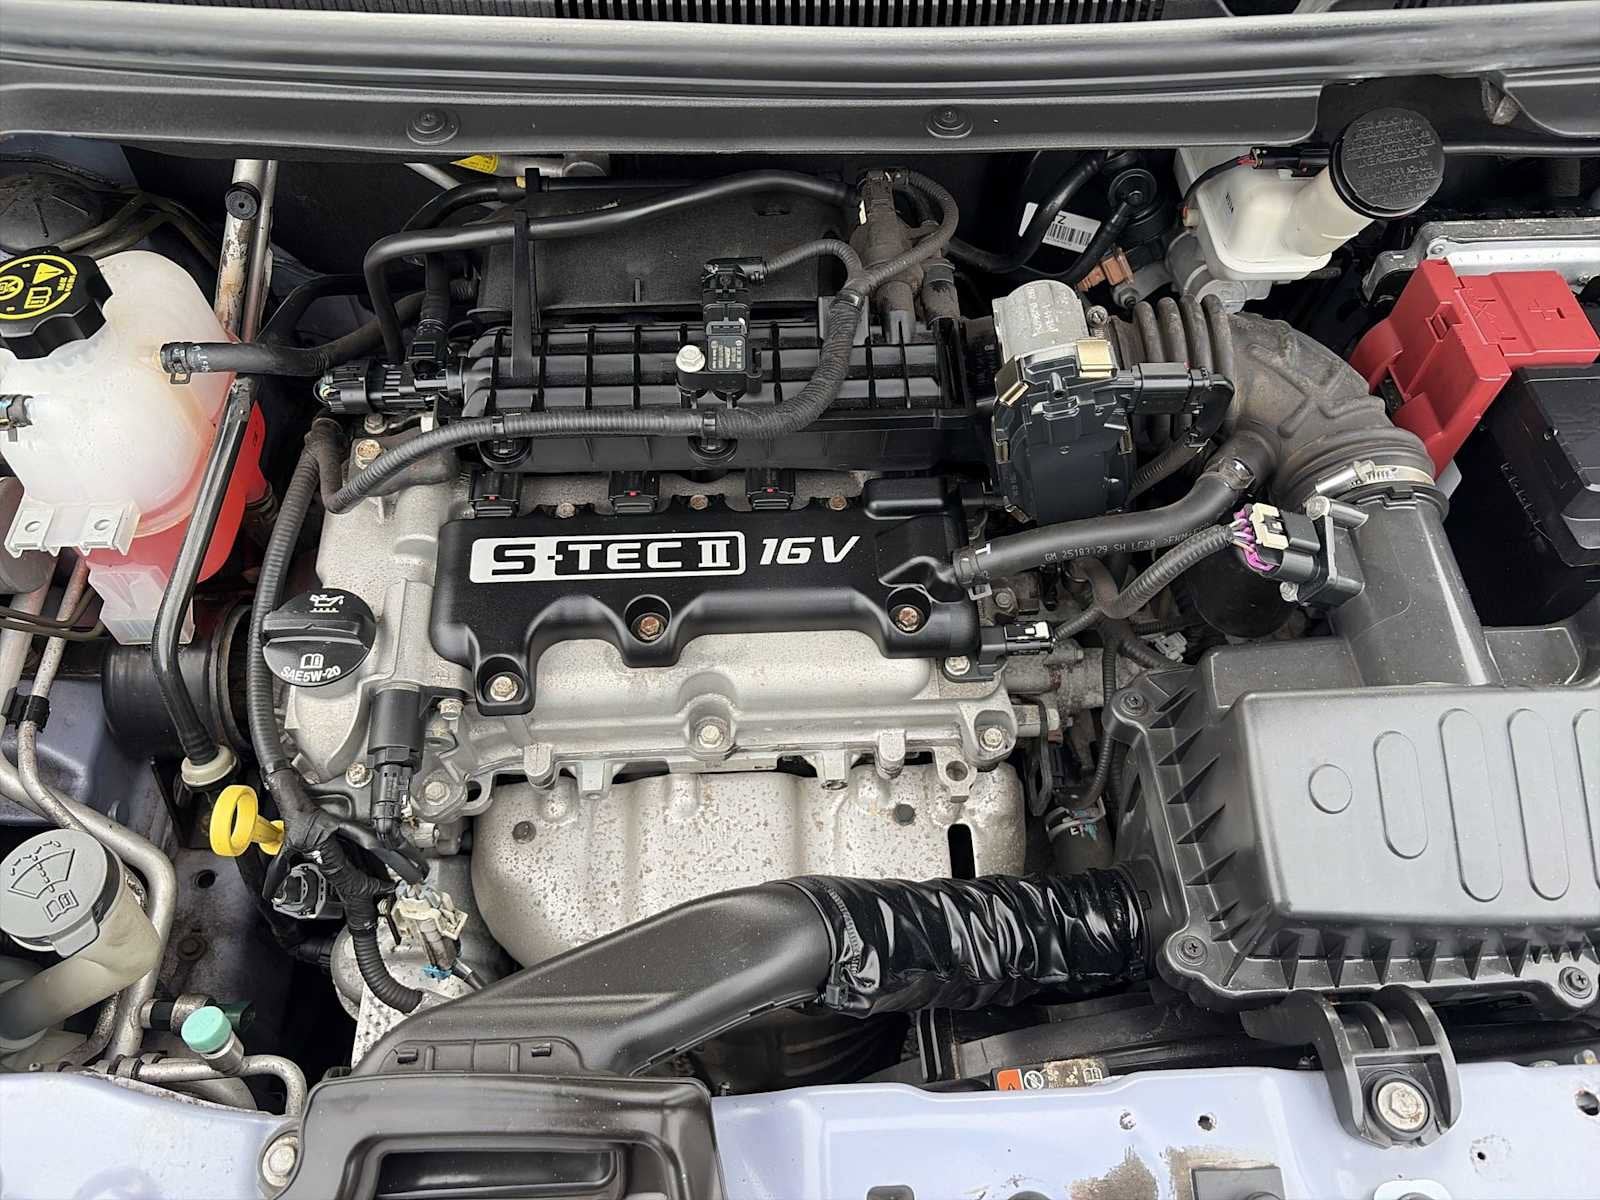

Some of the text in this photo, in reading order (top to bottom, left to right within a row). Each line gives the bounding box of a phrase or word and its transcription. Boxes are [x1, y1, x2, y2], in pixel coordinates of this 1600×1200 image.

[490, 535, 861, 576] S-TEC II 16V
[1044, 551, 1057, 562] GM
